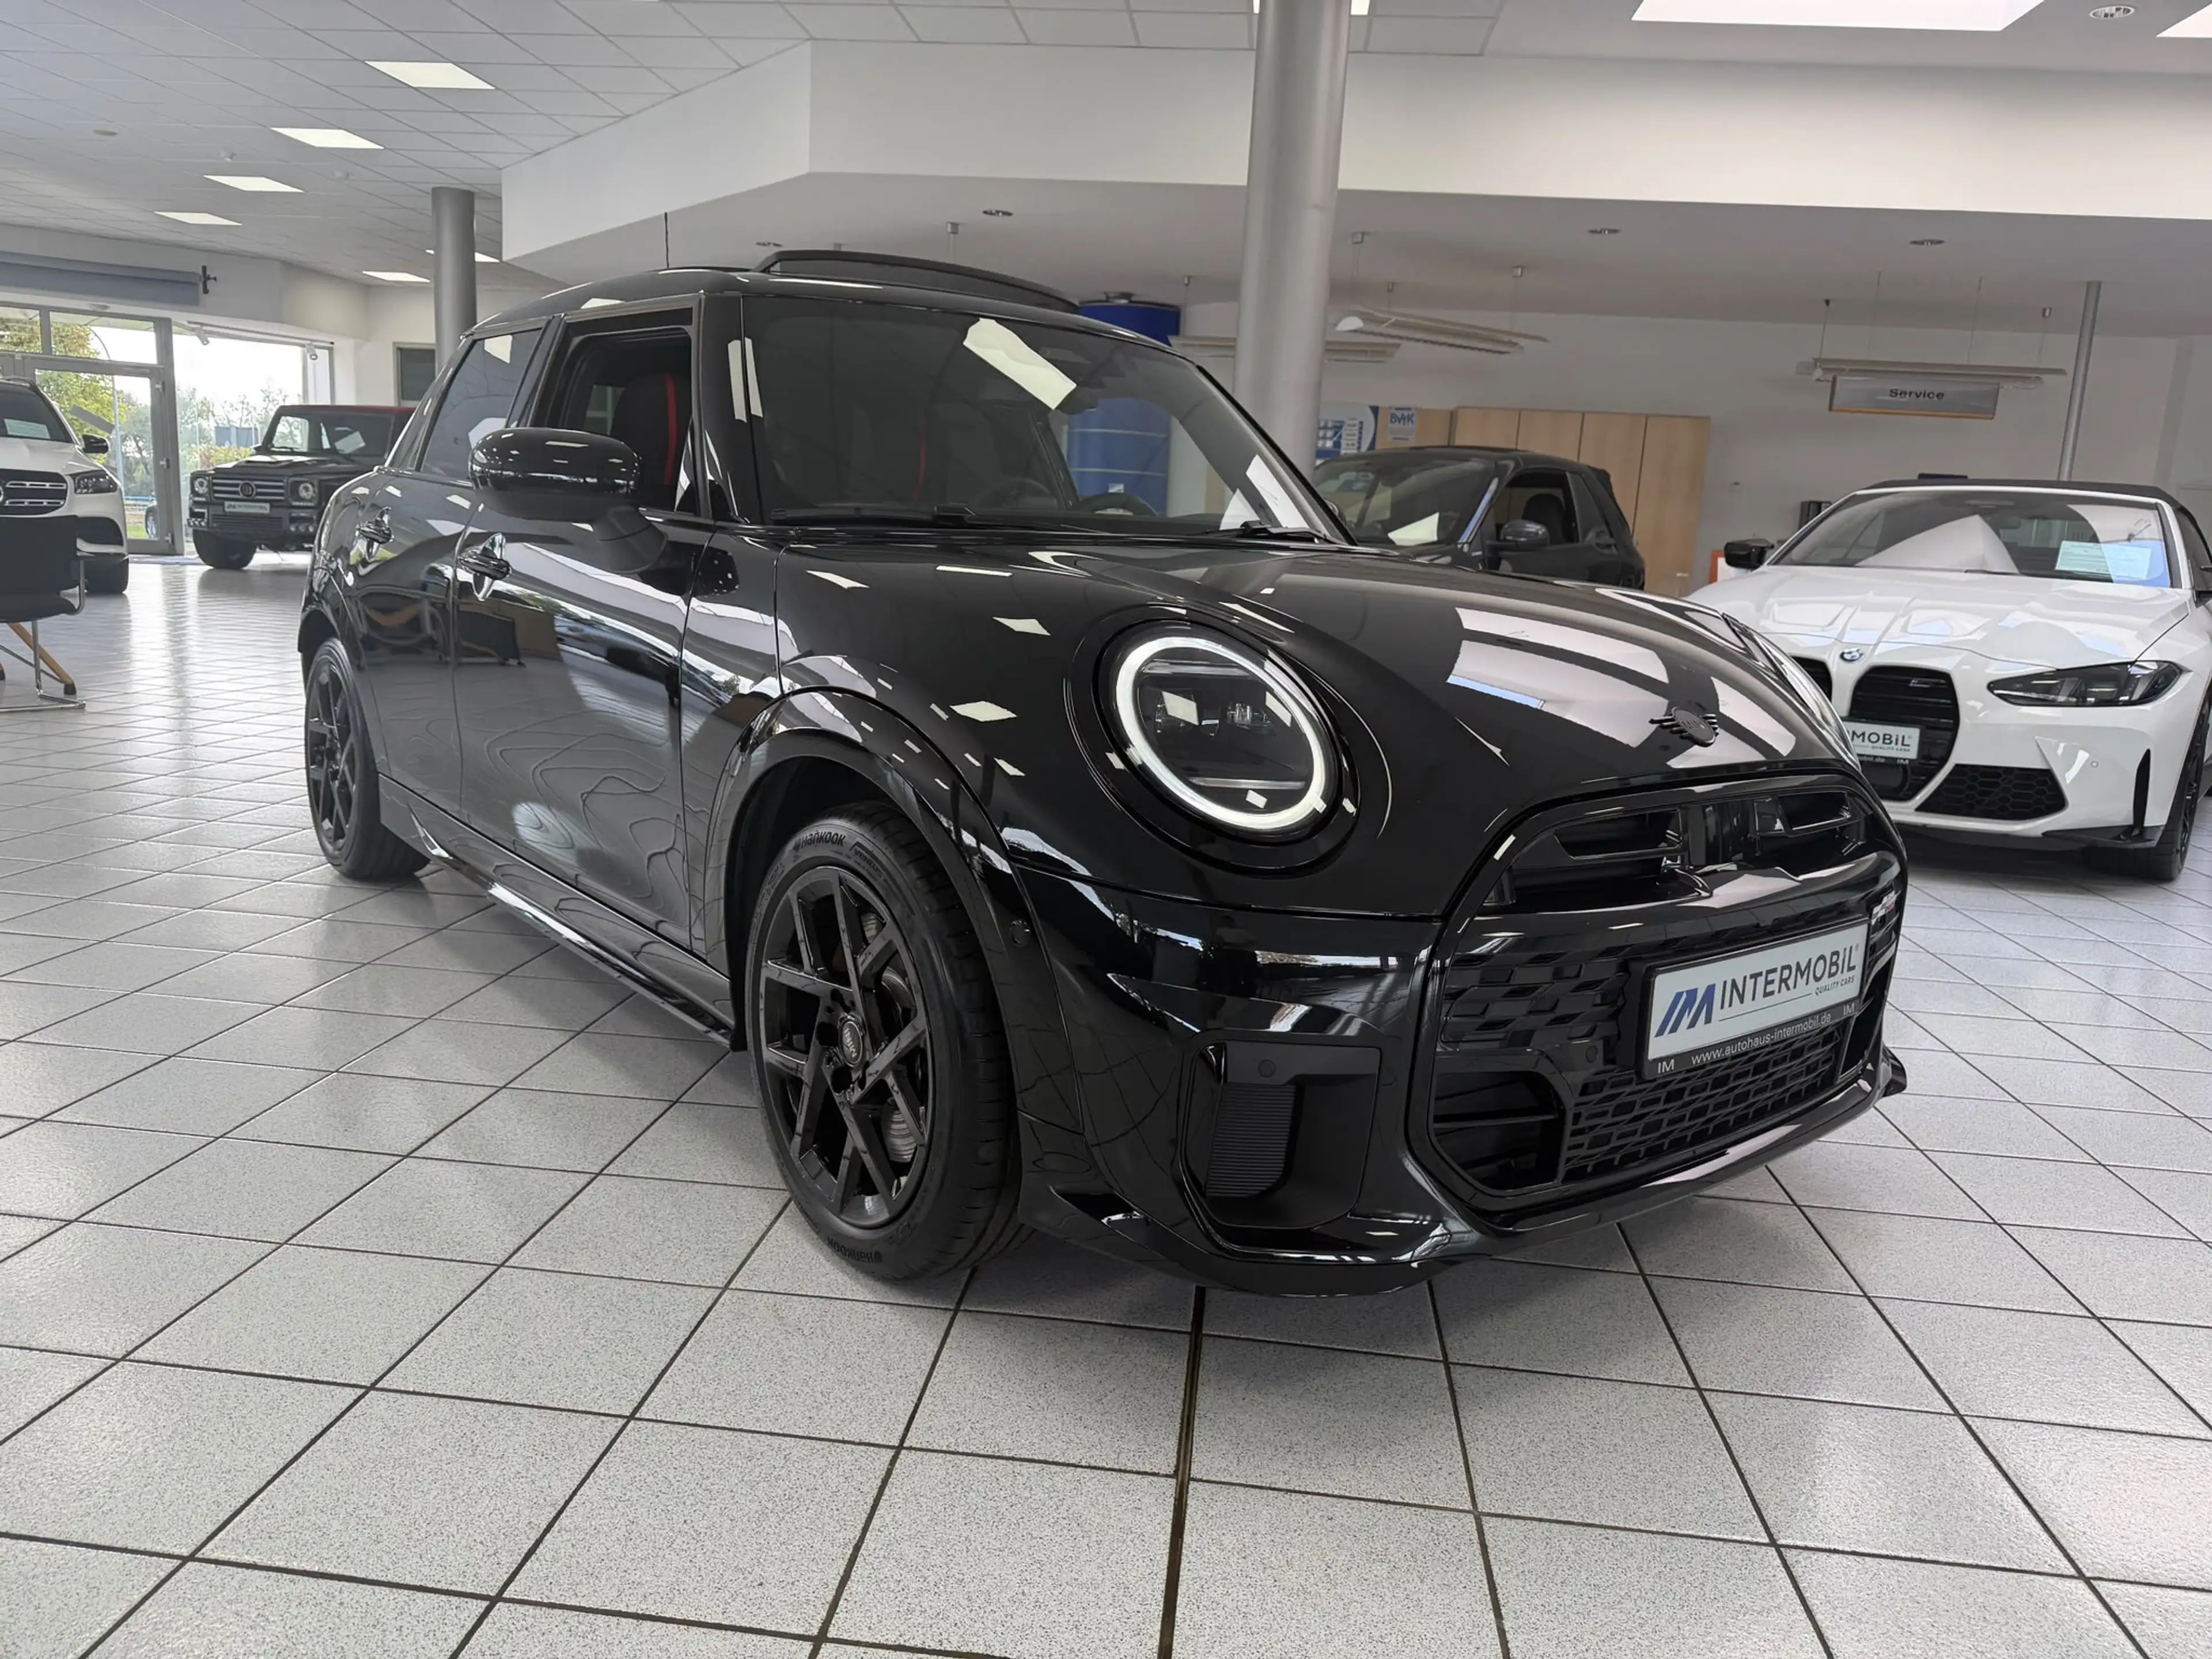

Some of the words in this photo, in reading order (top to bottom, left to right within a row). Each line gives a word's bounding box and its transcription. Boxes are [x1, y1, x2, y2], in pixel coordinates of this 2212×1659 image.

[1889, 388, 1945, 400] Service
[1815, 980, 1839, 996] QUALITY
[1840, 975, 1855, 987] CARS
[1657, 1058, 1675, 1074] IM
[1691, 1012, 1832, 1065] www.autohaus-intermobil.de
[1843, 1002, 1855, 1016] IM
